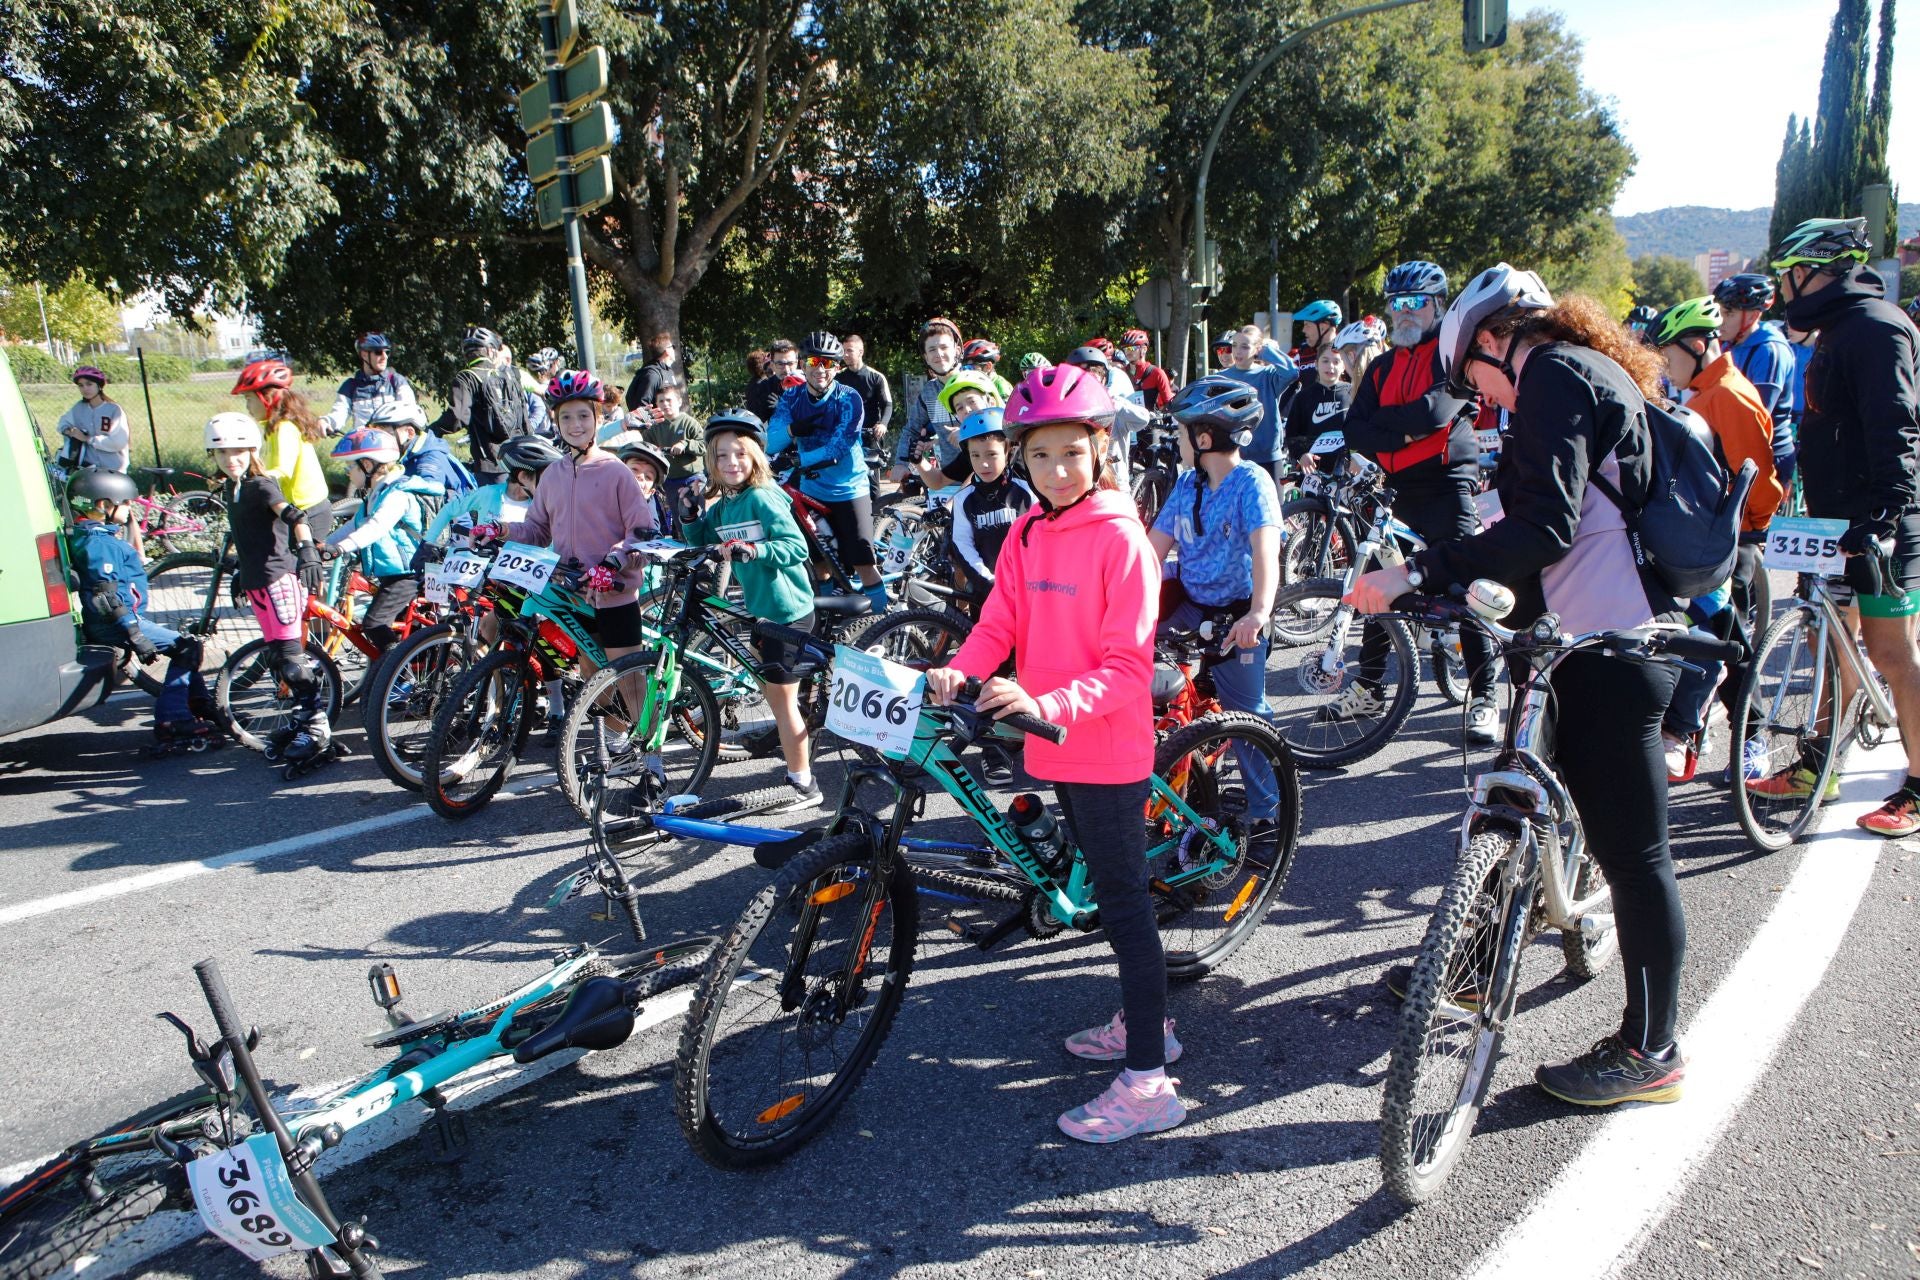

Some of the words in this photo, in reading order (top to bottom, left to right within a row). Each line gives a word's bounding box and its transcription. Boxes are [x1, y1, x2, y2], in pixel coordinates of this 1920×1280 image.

[1316, 401, 1341, 415] NIKE
[101, 416, 111, 432] B
[1316, 437, 1344, 448] 3390
[1305, 475, 1332, 494] 349
[1633, 532, 1644, 565] Quechua
[1774, 536, 1838, 557] 3155
[443, 561, 481, 575] 0403
[498, 554, 545, 579] 2036
[833, 677, 909, 725] 2066
[1508, 905, 1527, 962] ZOOM
[218, 1159, 293, 1246] 3689
[262, 1158, 278, 1189] Fiesta
[282, 1204, 312, 1235] Bicicleta
